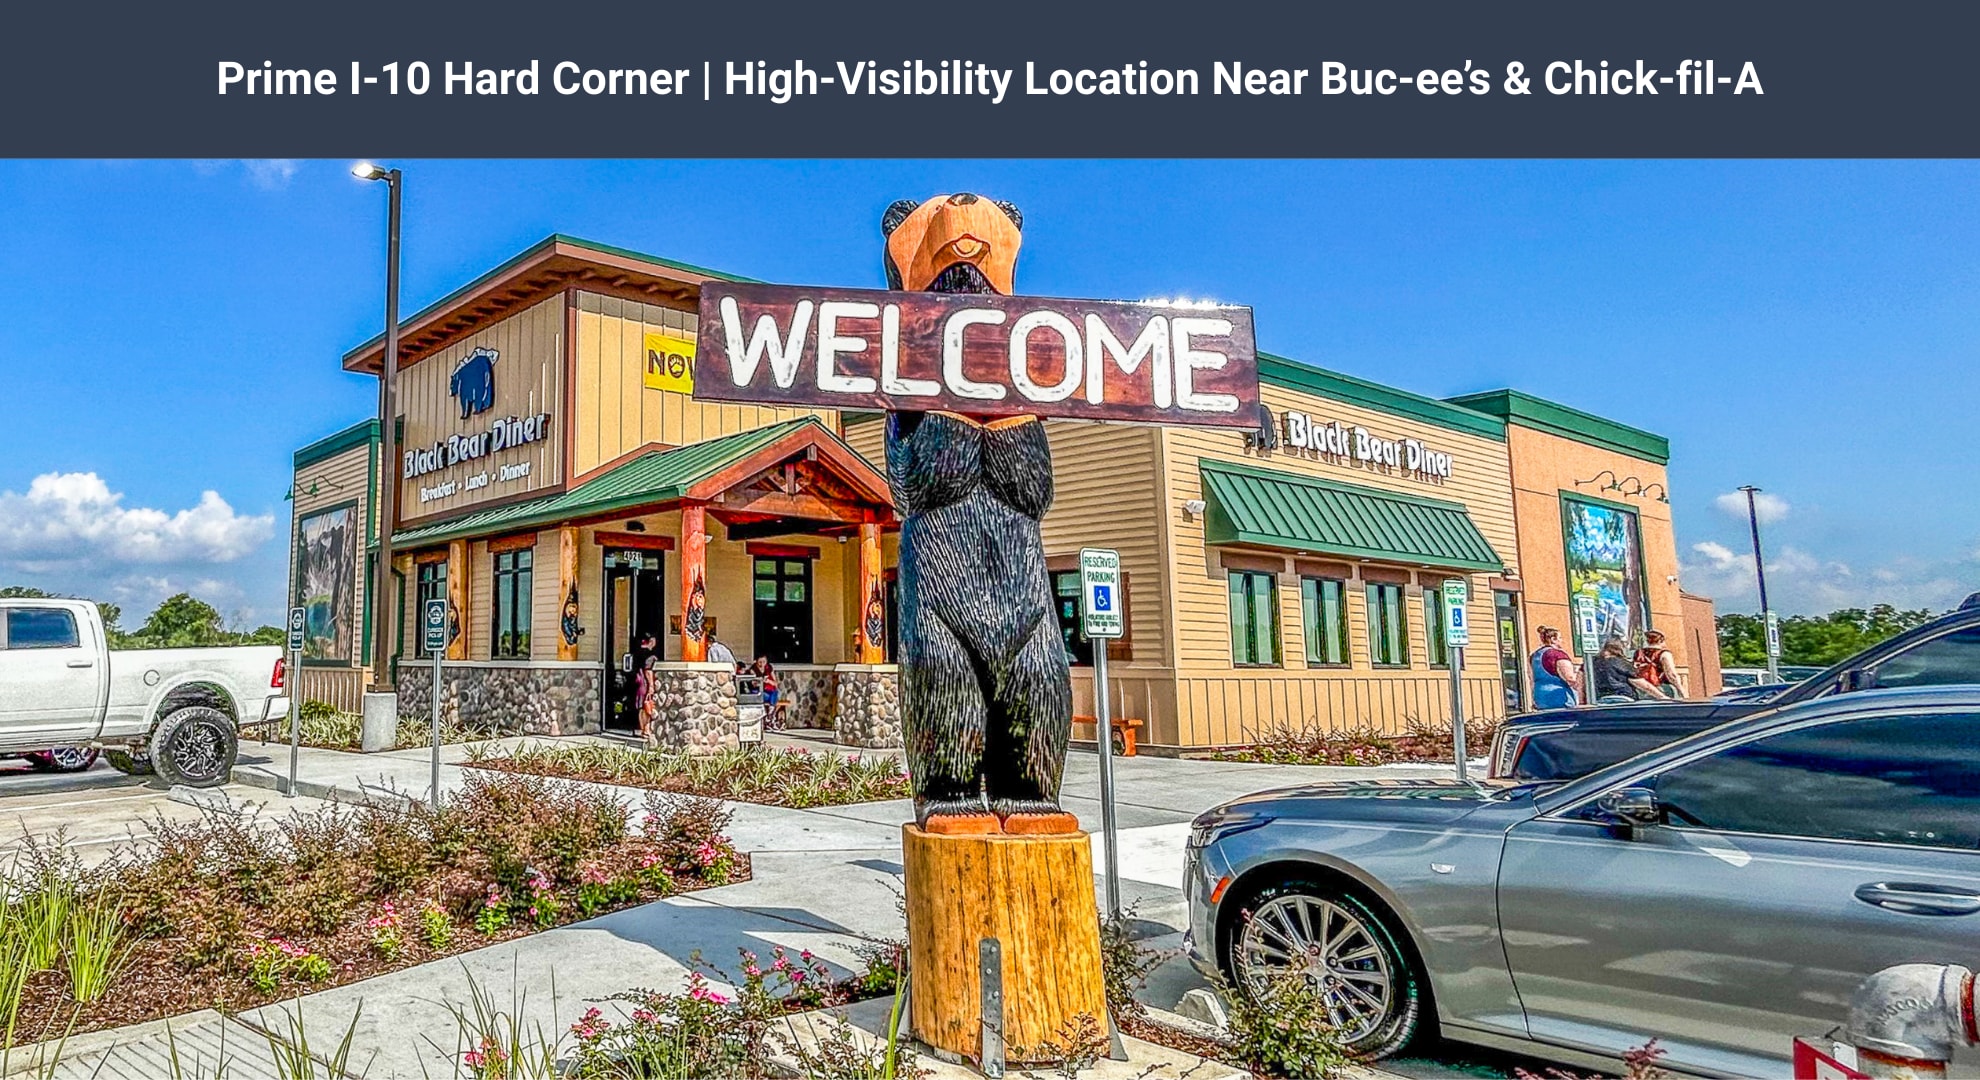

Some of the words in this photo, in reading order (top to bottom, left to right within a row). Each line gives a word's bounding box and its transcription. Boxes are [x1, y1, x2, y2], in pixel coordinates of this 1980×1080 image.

[719, 296, 1240, 411] WELCOME
[403, 441, 445, 479] Black
[447, 432, 489, 466] Bear
[492, 413, 547, 452] Diner
[1287, 411, 1350, 456] Black
[1353, 425, 1400, 467] Bear
[1403, 438, 1453, 478] Diner
[420, 480, 457, 503] Breakfast
[465, 471, 488, 492] Lunch
[500, 461, 531, 482] Dinner
[1084, 556, 1117, 568] RESERVED
[1087, 571, 1116, 584] PARKING
